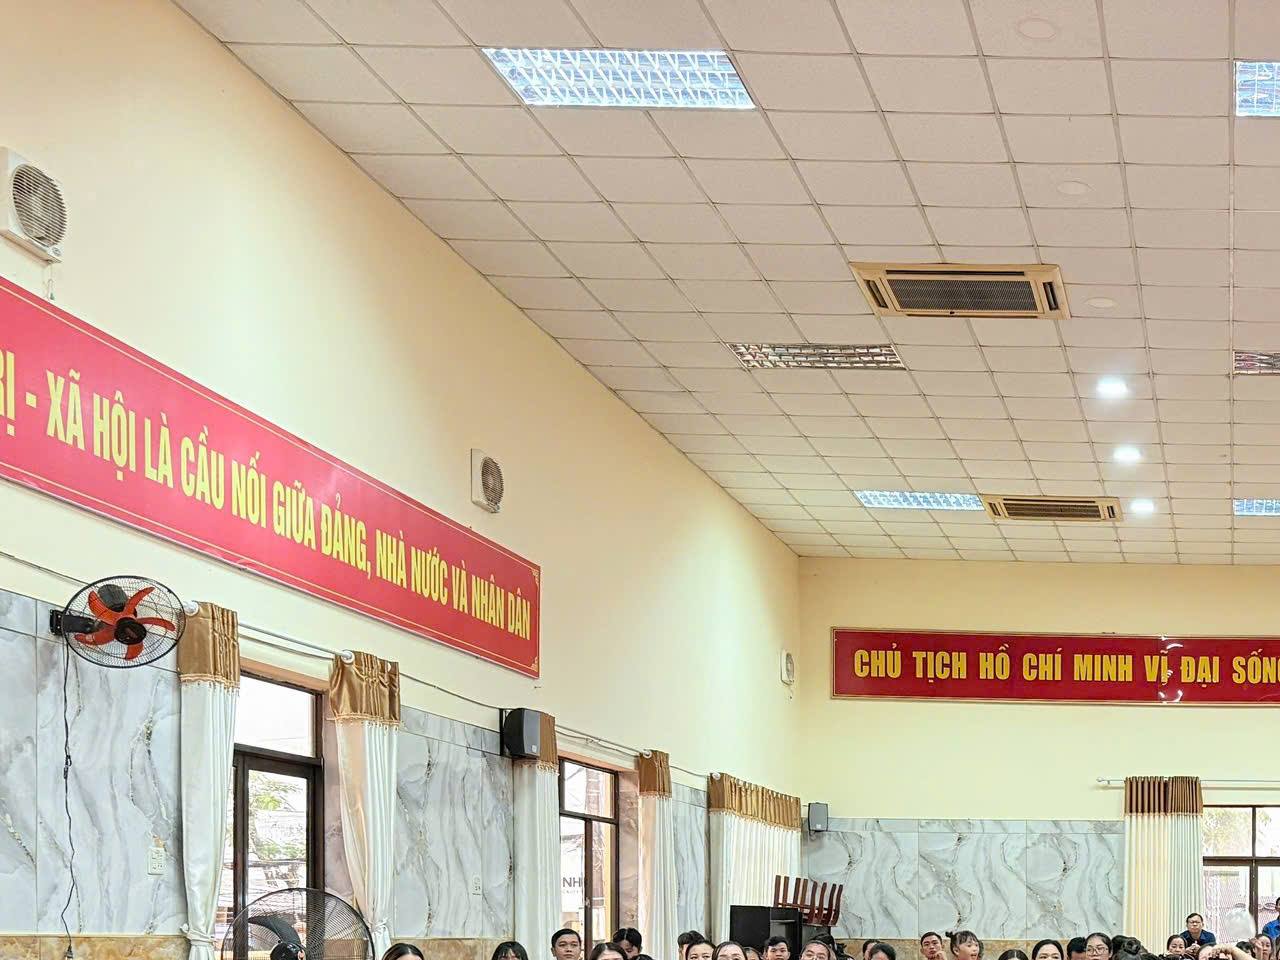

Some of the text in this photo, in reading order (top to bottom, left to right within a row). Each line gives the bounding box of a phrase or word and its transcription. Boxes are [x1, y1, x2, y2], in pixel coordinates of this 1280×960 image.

[26, 392, 36, 408] -
[47, 369, 85, 450] XÃ
[93, 390, 136, 481] HỘI
[145, 412, 173, 488] LÀ
[181, 426, 224, 509] CẦU
[231, 451, 266, 528] NỐI
[273, 480, 317, 550] GIỮA
[324, 493, 371, 579] ĐẢNG,
[376, 529, 406, 588] NHÀ
[411, 547, 447, 605] NƯỚC
[452, 560, 467, 613] VÀ
[472, 575, 504, 628] NHÂN
[508, 588, 529, 640] DÂN
[855, 643, 901, 678] CHỦ
[913, 652, 966, 682] TỊCH
[980, 644, 1010, 679] HỒ
[1023, 648, 1061, 680] CHÍ
[1074, 654, 1132, 681] MINH
[1144, 649, 1168, 683] VĨ
[1180, 654, 1219, 684] ĐẠI
